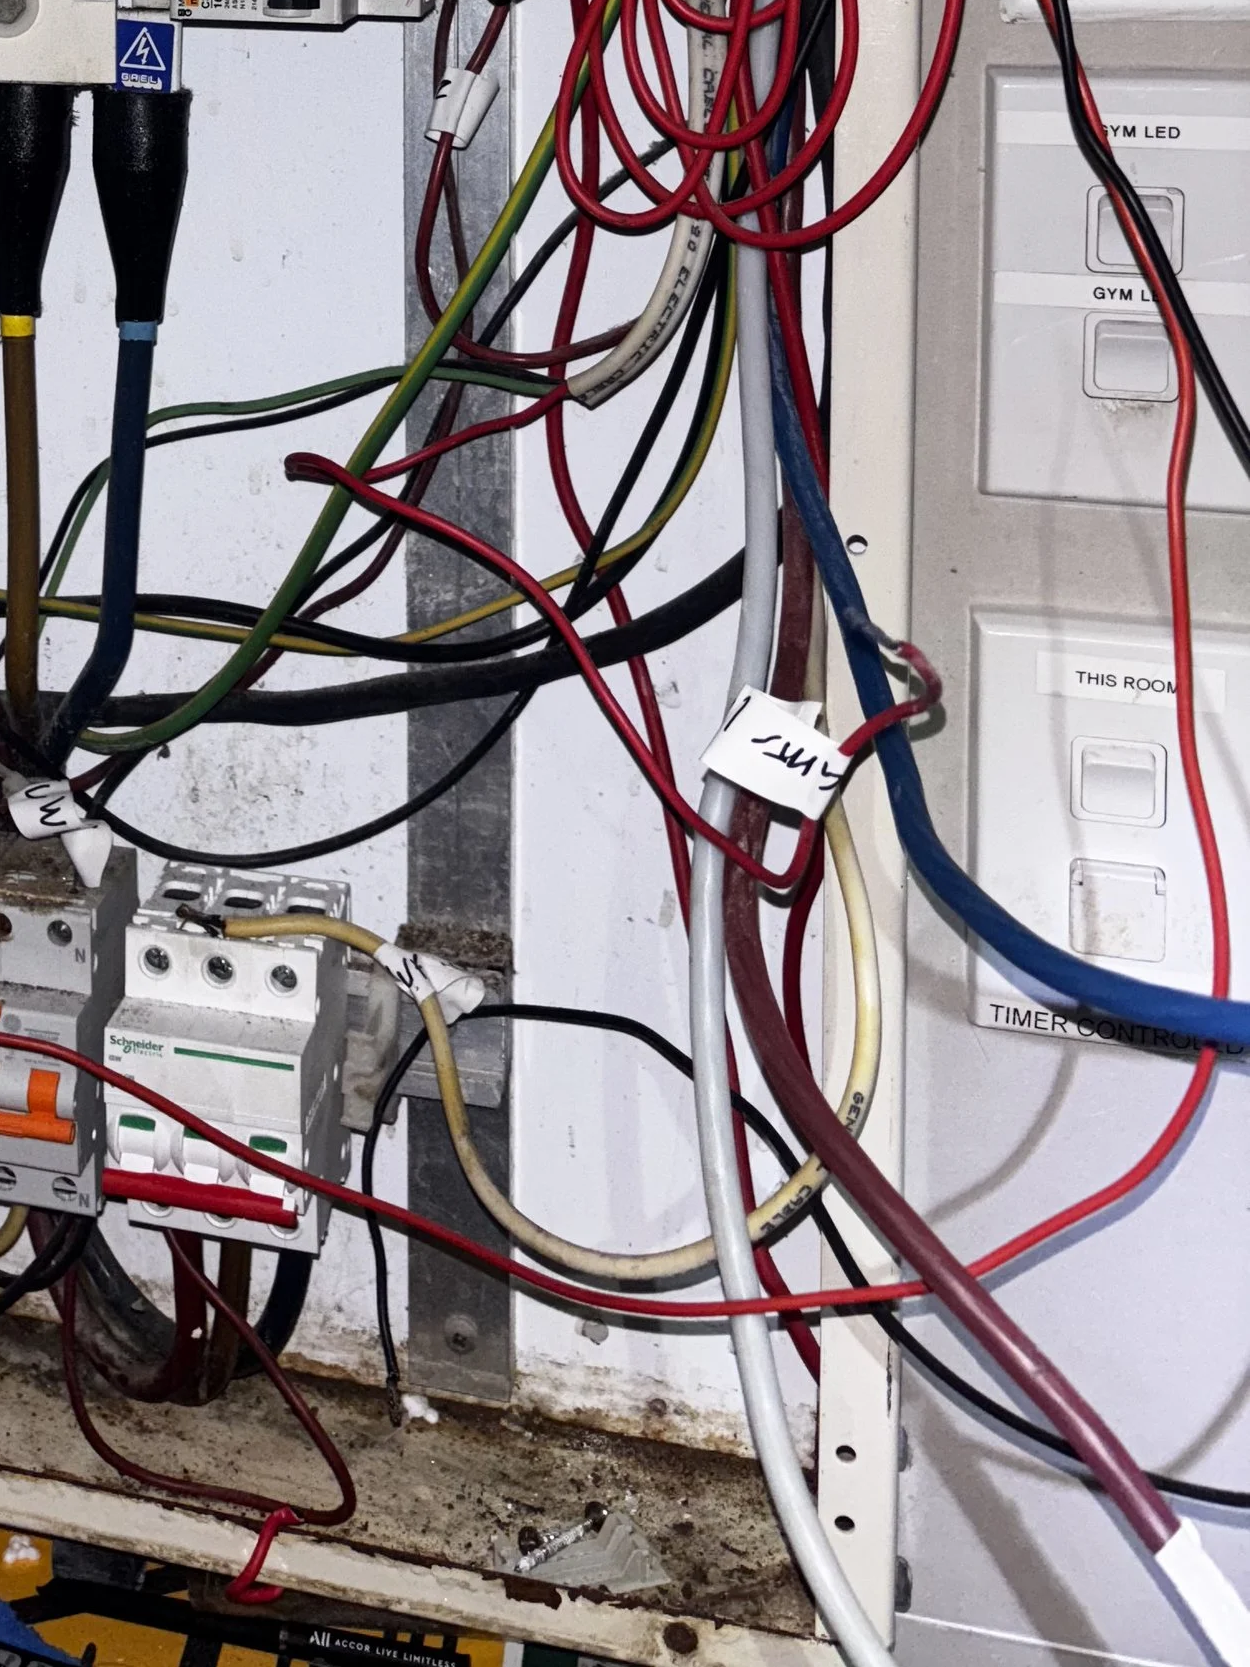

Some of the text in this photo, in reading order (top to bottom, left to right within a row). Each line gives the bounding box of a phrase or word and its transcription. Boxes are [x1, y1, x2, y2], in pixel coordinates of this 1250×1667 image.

[1144, 126, 1181, 139] LED
[1093, 286, 1133, 301] GYM
[1075, 670, 1118, 688] THIS
[75, 949, 86, 964] N
[990, 1002, 1068, 1034] TIMER
[109, 1035, 164, 1053] Schneider
[78, 1193, 90, 1208] N
[334, 1638, 371, 1653] ACCOR
[376, 1647, 398, 1659] LIVE
[402, 1652, 457, 1667] LIMITLESS
